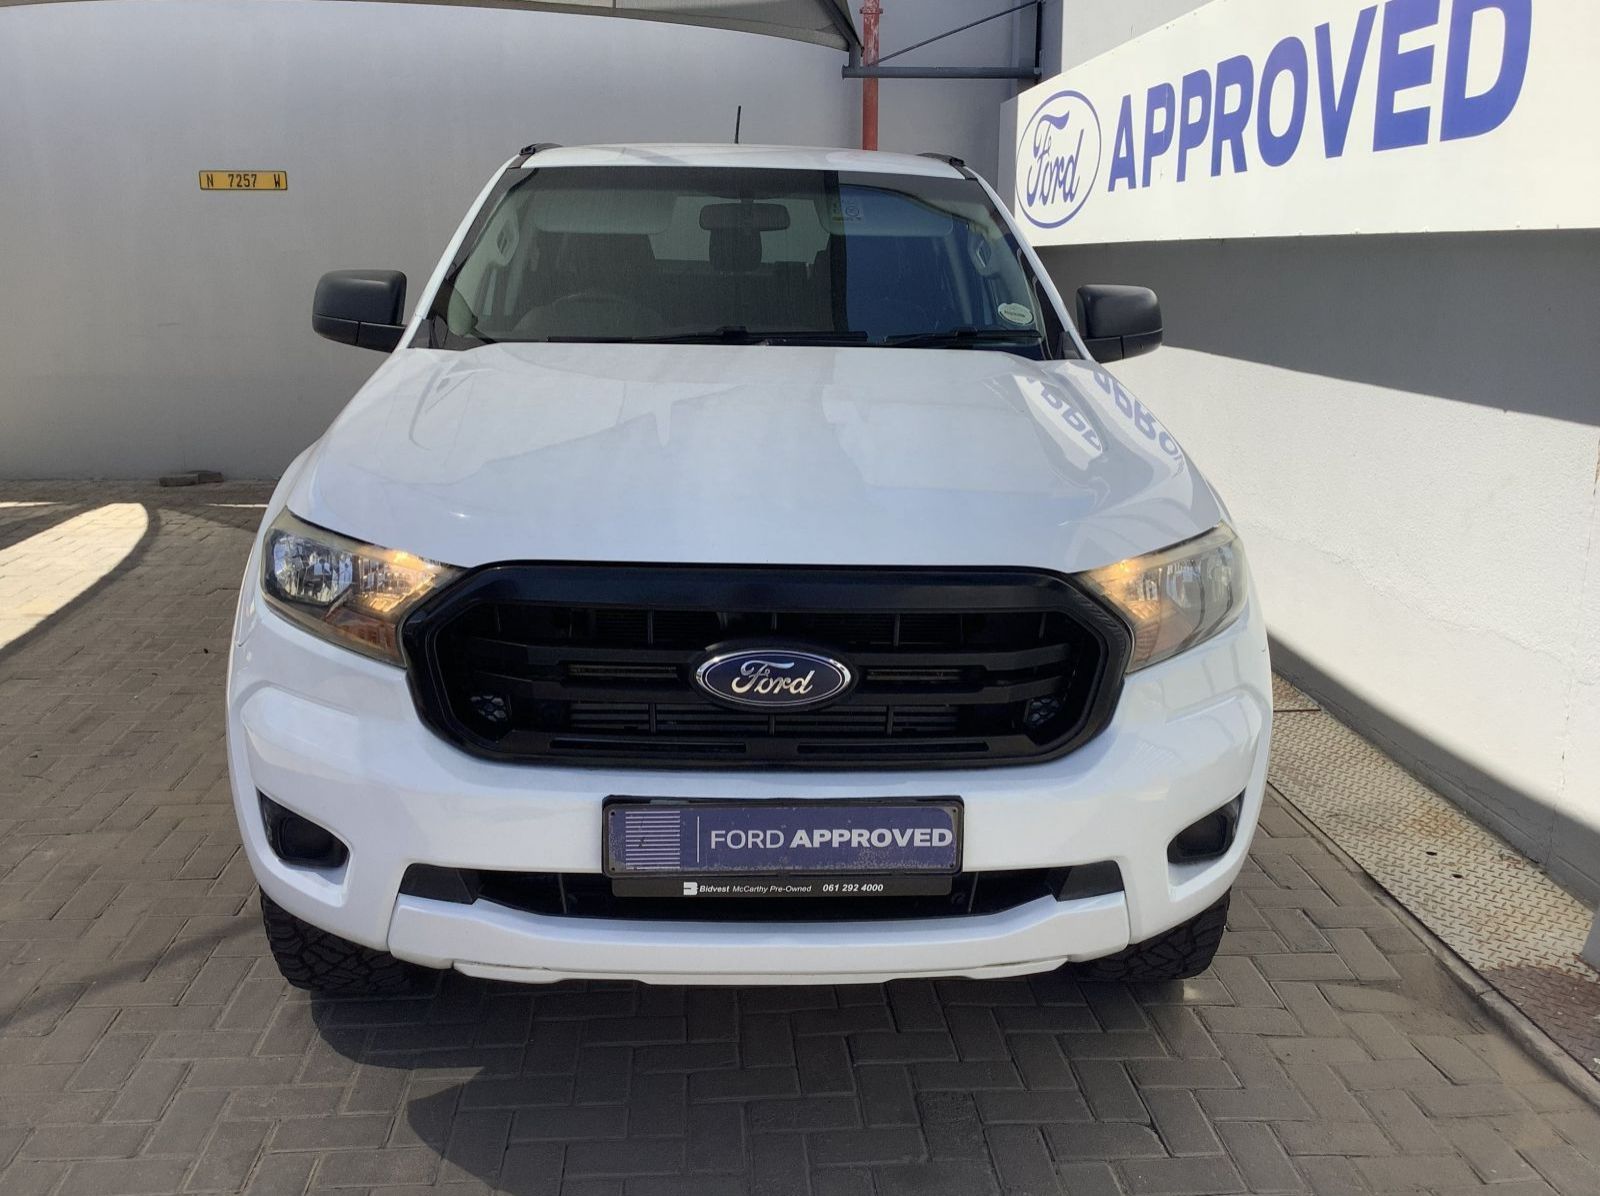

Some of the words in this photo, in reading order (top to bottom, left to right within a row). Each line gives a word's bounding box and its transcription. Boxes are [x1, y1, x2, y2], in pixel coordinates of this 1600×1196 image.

[1026, 110, 1084, 208] Ford
[1108, 0, 1533, 192] APPROVED
[206, 173, 214, 188] N
[228, 173, 257, 188] 7257
[273, 173, 281, 188] W
[731, 659, 816, 694] Ford
[710, 829, 785, 849] FORD
[789, 827, 953, 848] APPROVED
[699, 885, 730, 893] Bidvest
[732, 885, 768, 894] McCarthy
[769, 885, 812, 893] Pre-Owned
[822, 883, 840, 892] 061
[841, 883, 860, 892] 292
[860, 883, 884, 892] 4000
